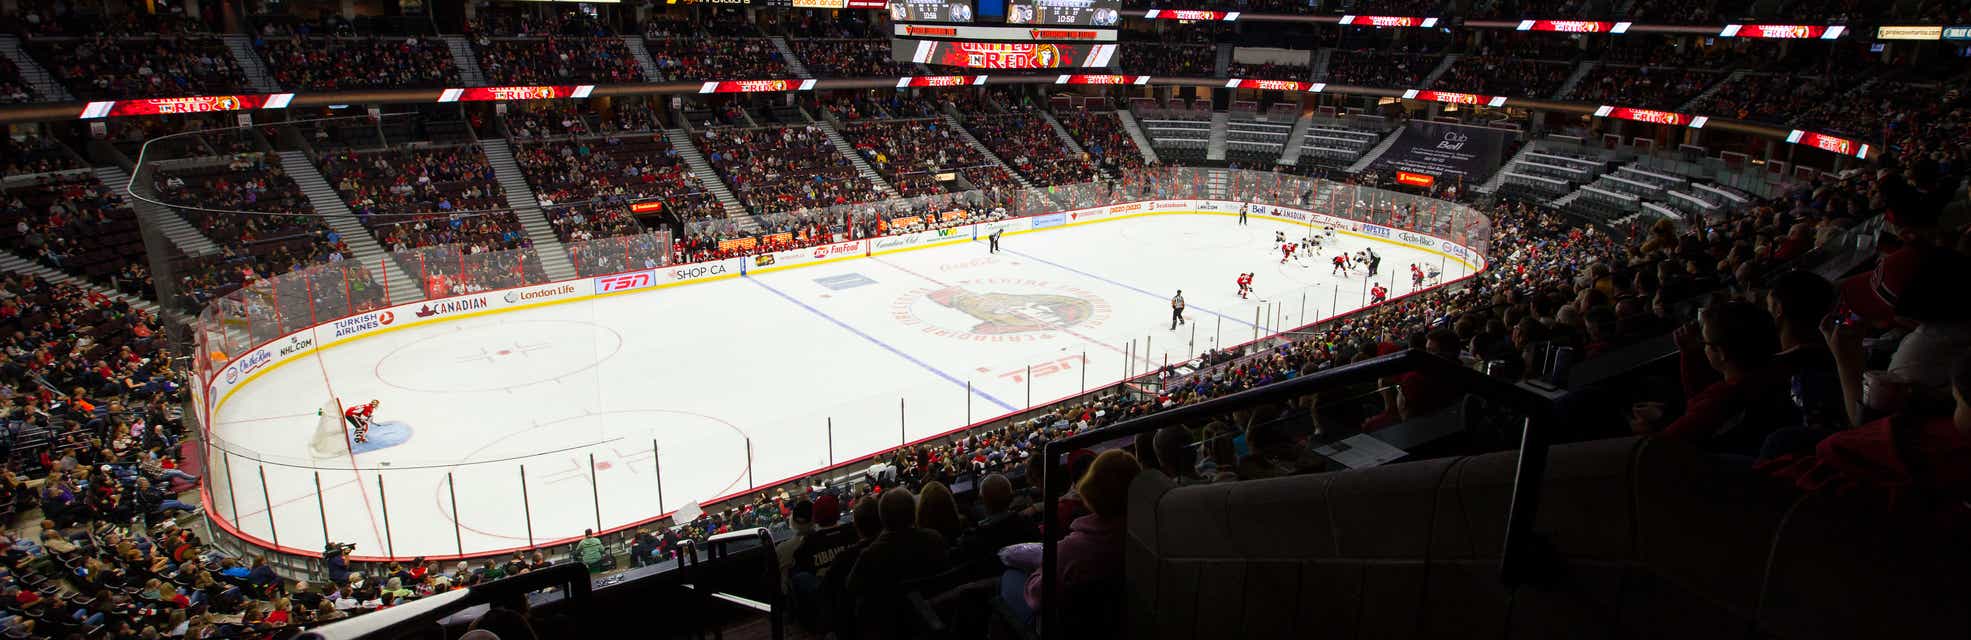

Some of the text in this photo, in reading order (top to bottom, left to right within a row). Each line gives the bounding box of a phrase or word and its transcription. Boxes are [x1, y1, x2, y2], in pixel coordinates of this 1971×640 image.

[1444, 131, 1468, 142] Club
[1436, 140, 1464, 151] Bell
[1252, 205, 1266, 214] Bell
[676, 267, 707, 281] SHOP
[709, 264, 727, 275] CA
[600, 274, 650, 292] TSN
[520, 284, 576, 301] London Life
[433, 296, 488, 315] CANADIAN
[334, 313, 378, 329] TURKISH
[335, 321, 379, 338] AIRLINES
[279, 338, 313, 358] NHL.COM
